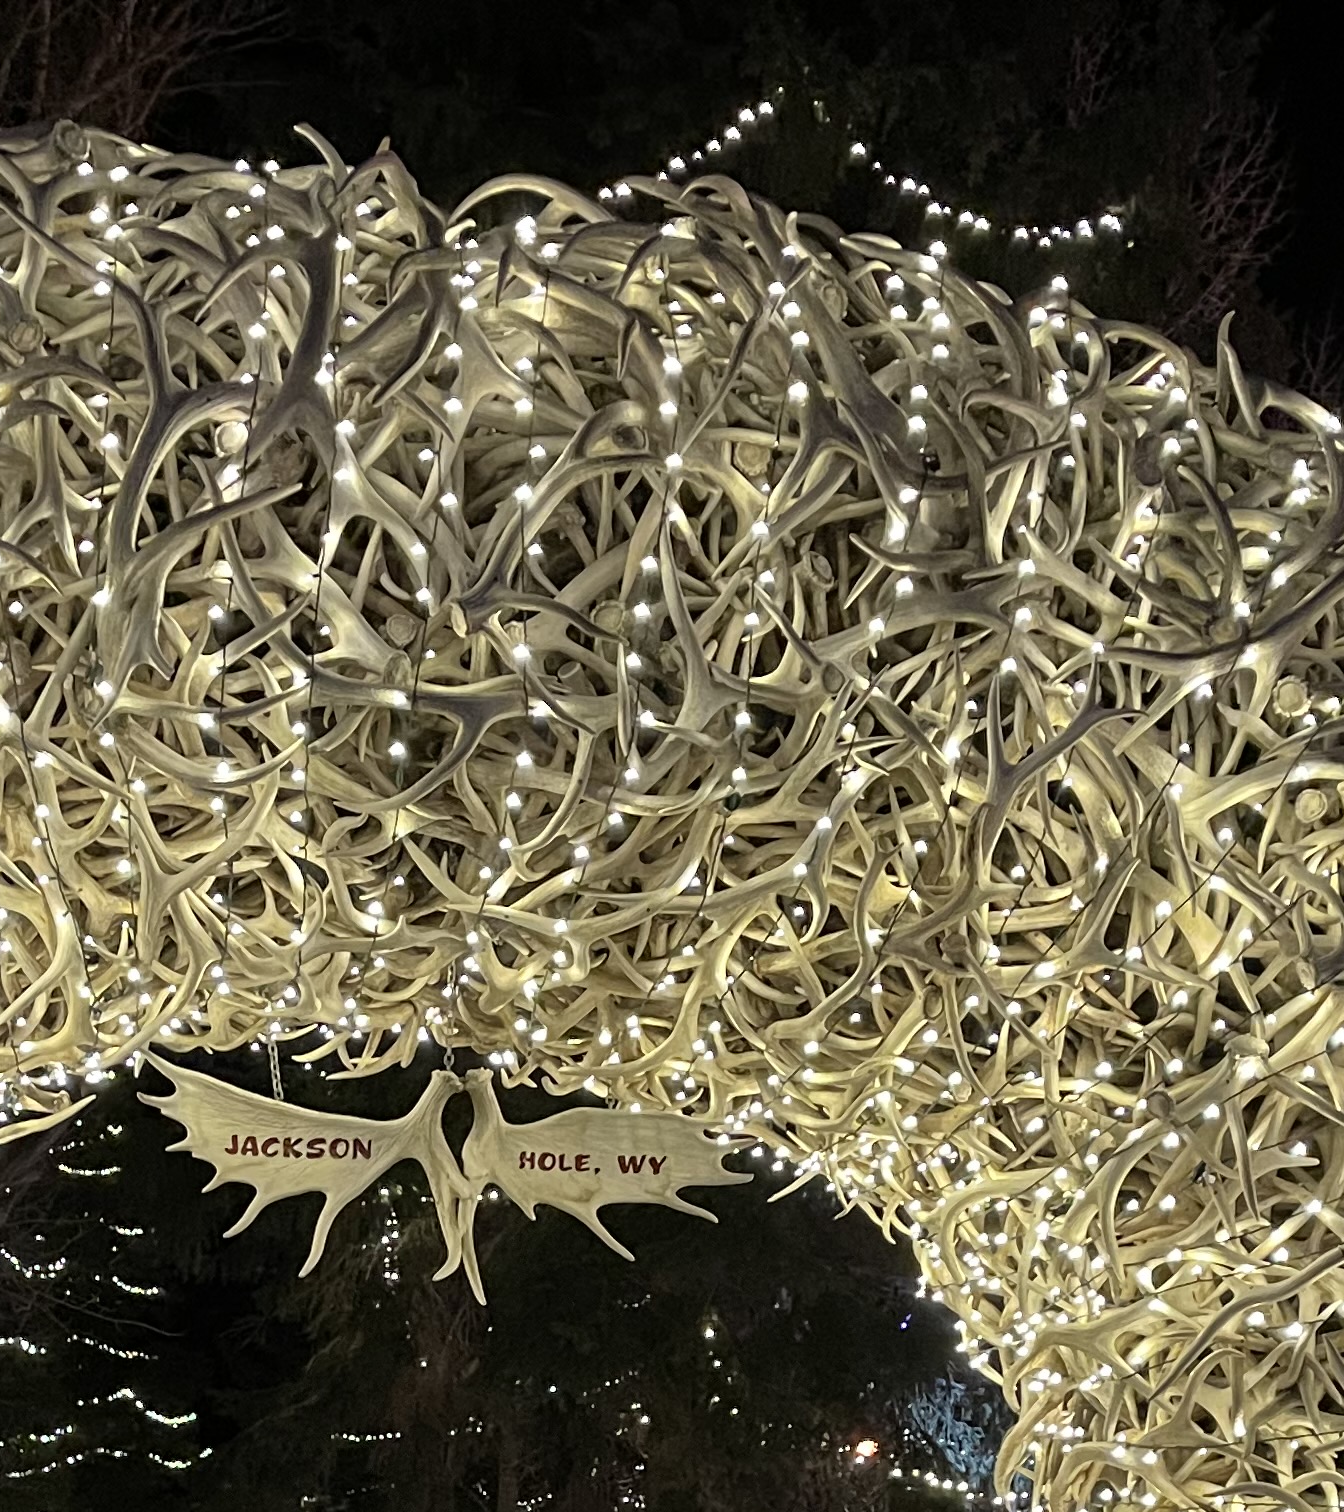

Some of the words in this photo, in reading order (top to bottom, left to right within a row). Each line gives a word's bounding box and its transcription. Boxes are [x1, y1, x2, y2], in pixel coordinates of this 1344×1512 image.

[224, 1134, 373, 1160] JACKSON
[518, 1150, 601, 1176] HOLE,
[616, 1154, 668, 1176] WY
